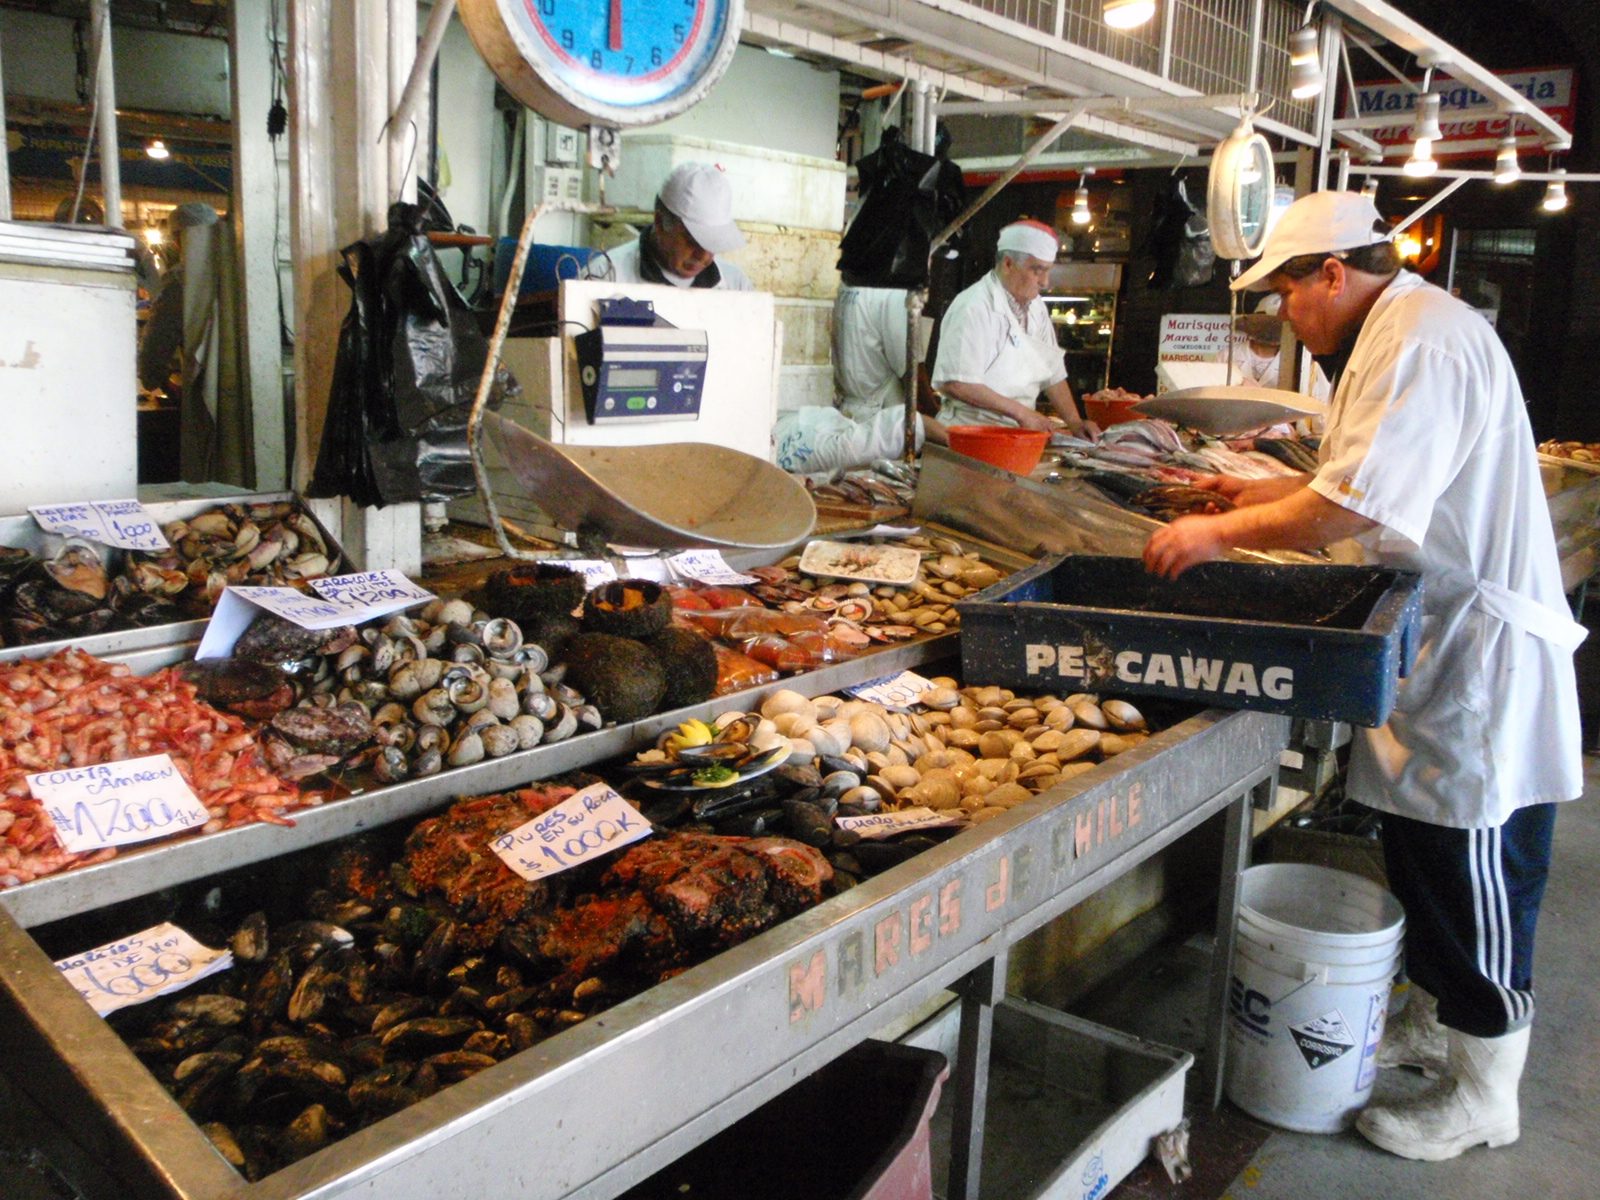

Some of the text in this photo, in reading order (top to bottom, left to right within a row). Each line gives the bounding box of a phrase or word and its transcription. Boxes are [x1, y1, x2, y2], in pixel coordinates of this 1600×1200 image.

[562, 29, 574, 49] 9
[673, 24, 685, 44] 5
[591, 49, 602, 69] 8
[624, 56, 634, 73] 7
[651, 47, 662, 66] 6
[1359, 77, 1556, 112] Marsquia
[1167, 319, 1232, 332] Marisque
[1204, 332, 1218, 342] de
[1161, 353, 1205, 362] MARISCAL
